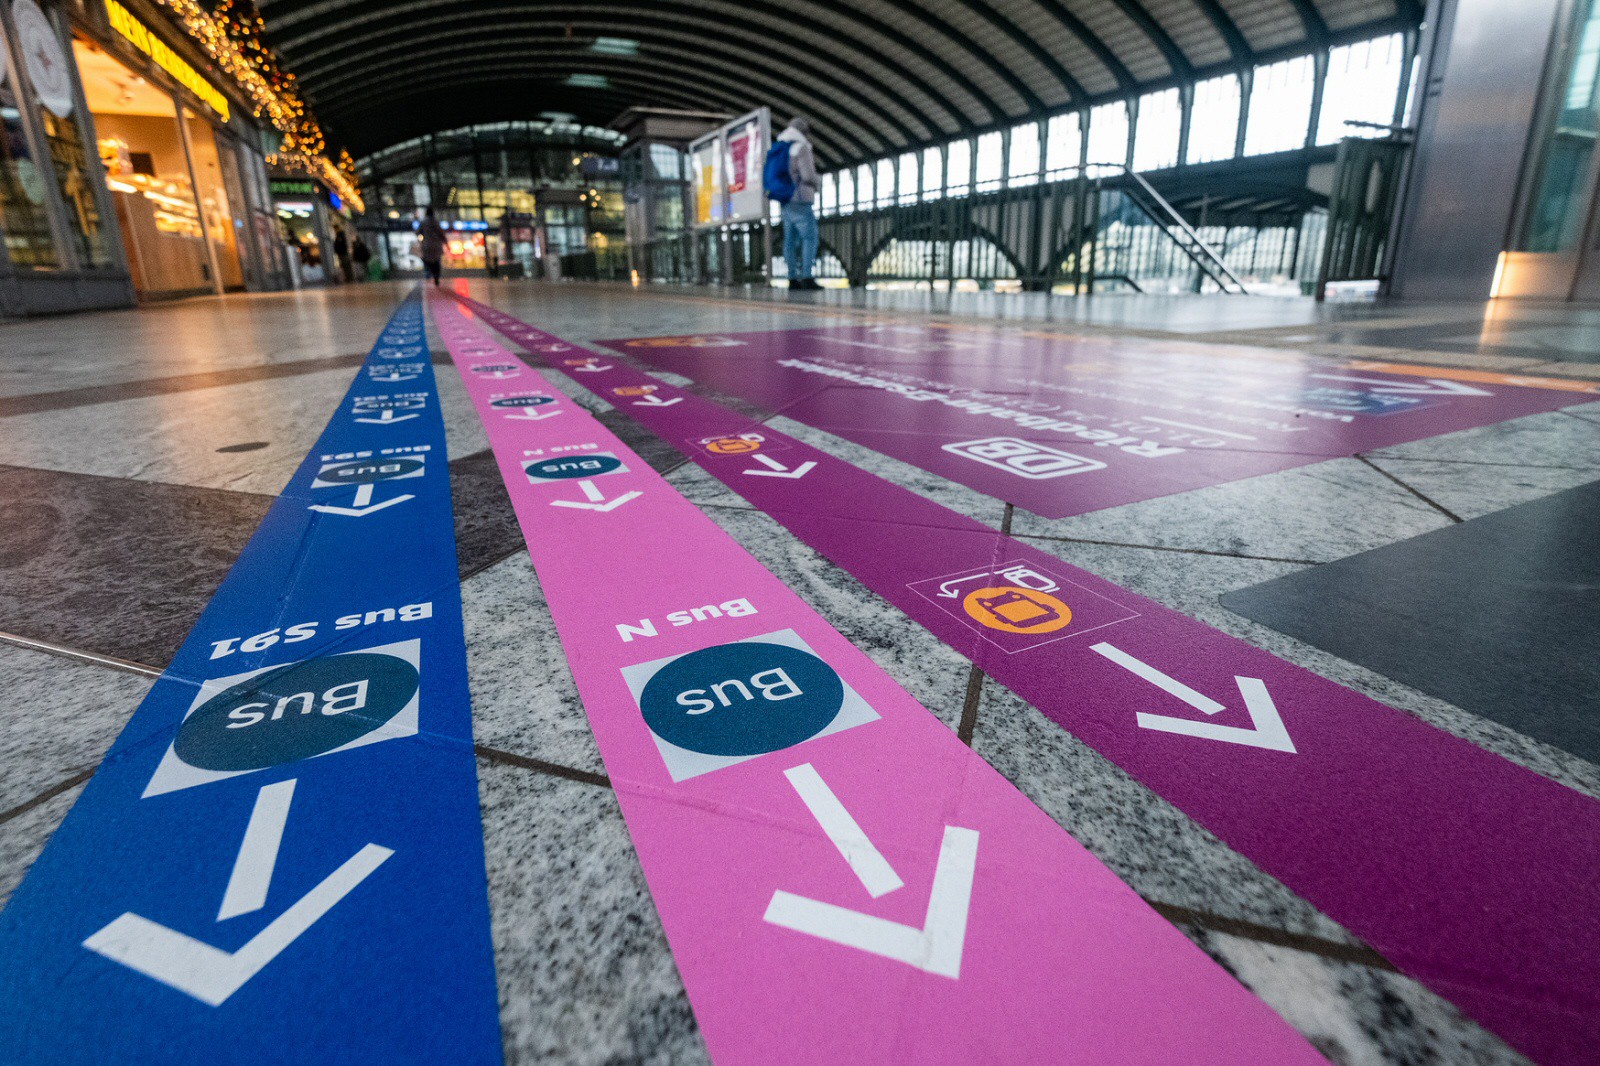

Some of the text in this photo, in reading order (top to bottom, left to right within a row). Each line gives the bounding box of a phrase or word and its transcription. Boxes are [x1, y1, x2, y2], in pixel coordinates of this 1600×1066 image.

[320, 444, 431, 462] Bus S91
[550, 443, 599, 453] Bus
[966, 441, 1084, 474] DB
[338, 463, 401, 477] Bus
[542, 460, 602, 473] Bus
[209, 601, 433, 661] Bus S91
[615, 597, 759, 643] Bus N
[225, 679, 369, 730] Bus
[675, 667, 804, 716] Bus
